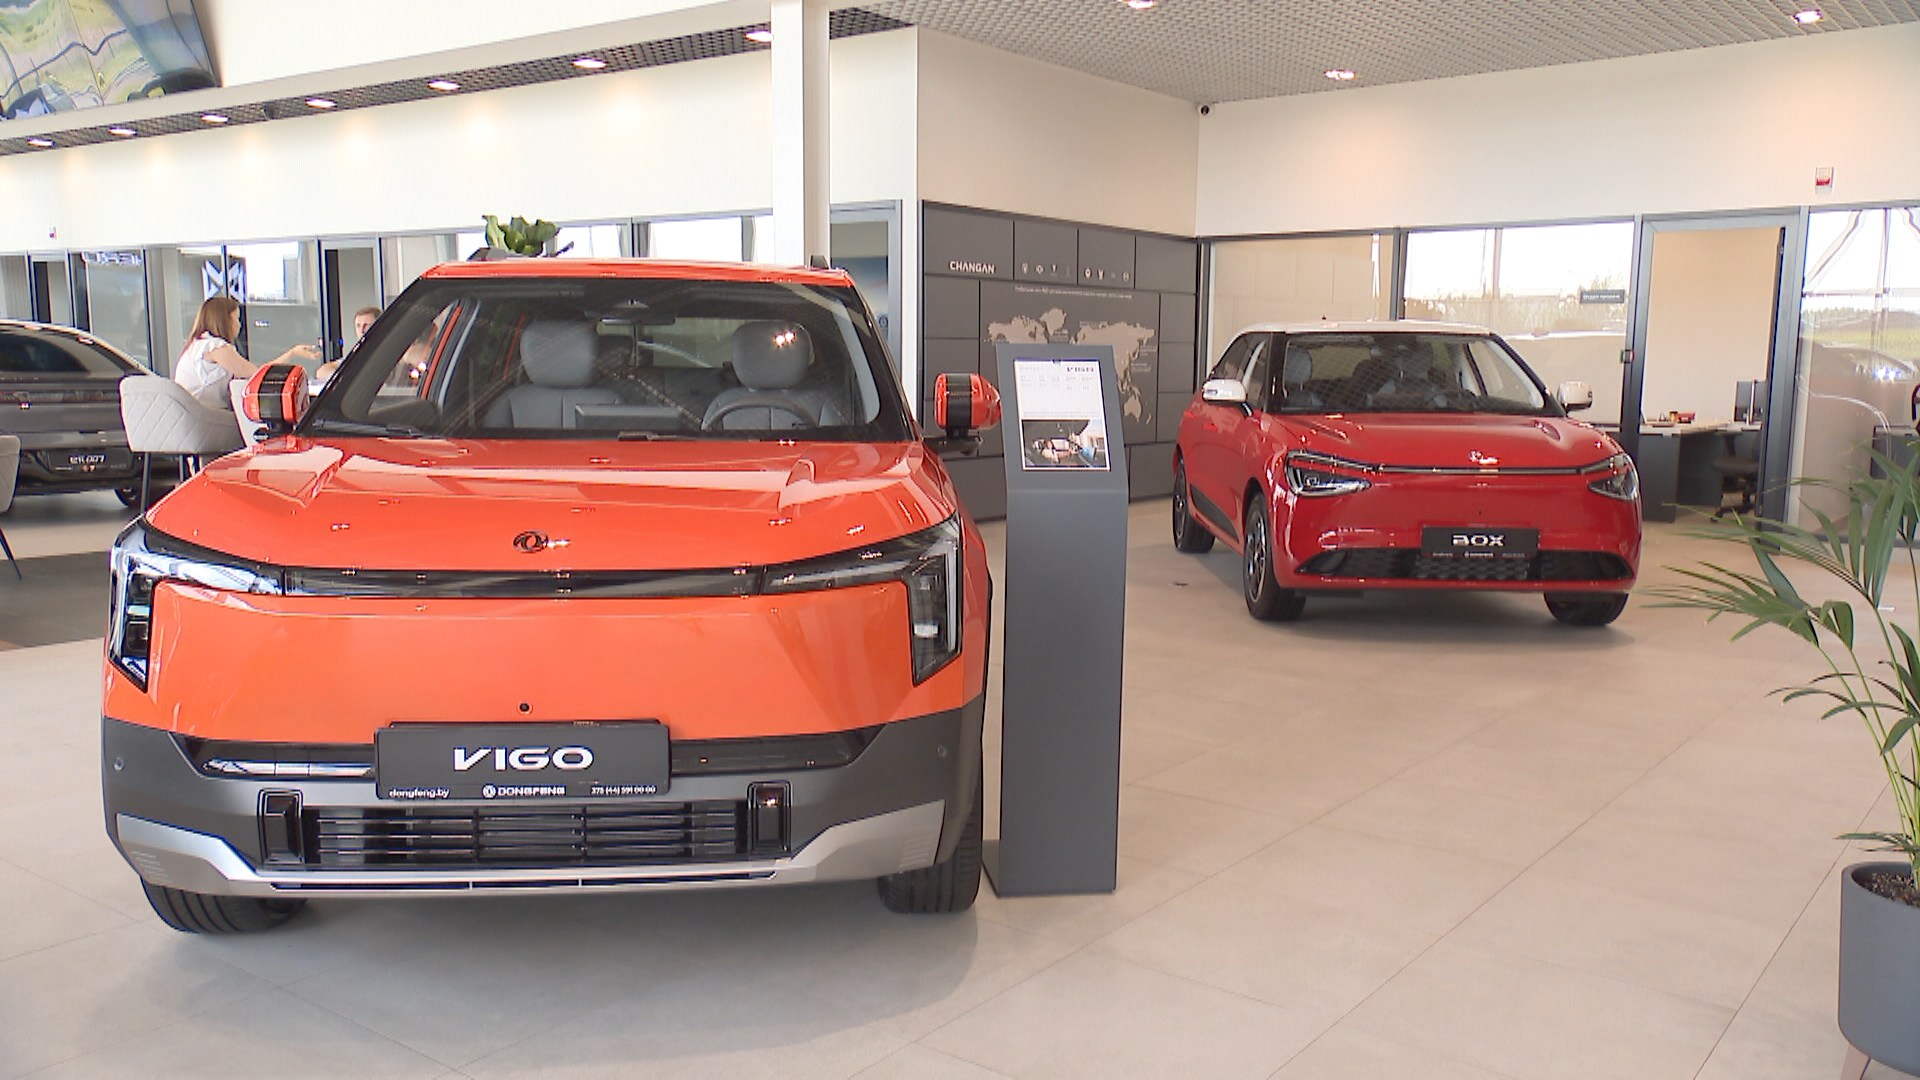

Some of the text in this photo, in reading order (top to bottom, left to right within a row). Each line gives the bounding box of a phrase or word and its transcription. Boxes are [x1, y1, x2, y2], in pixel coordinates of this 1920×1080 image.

[949, 260, 996, 275] CHANGAN
[1452, 534, 1504, 547] BOX
[453, 745, 594, 771] VIGO
[388, 785, 566, 798] dongfeng.by DONGFENG
